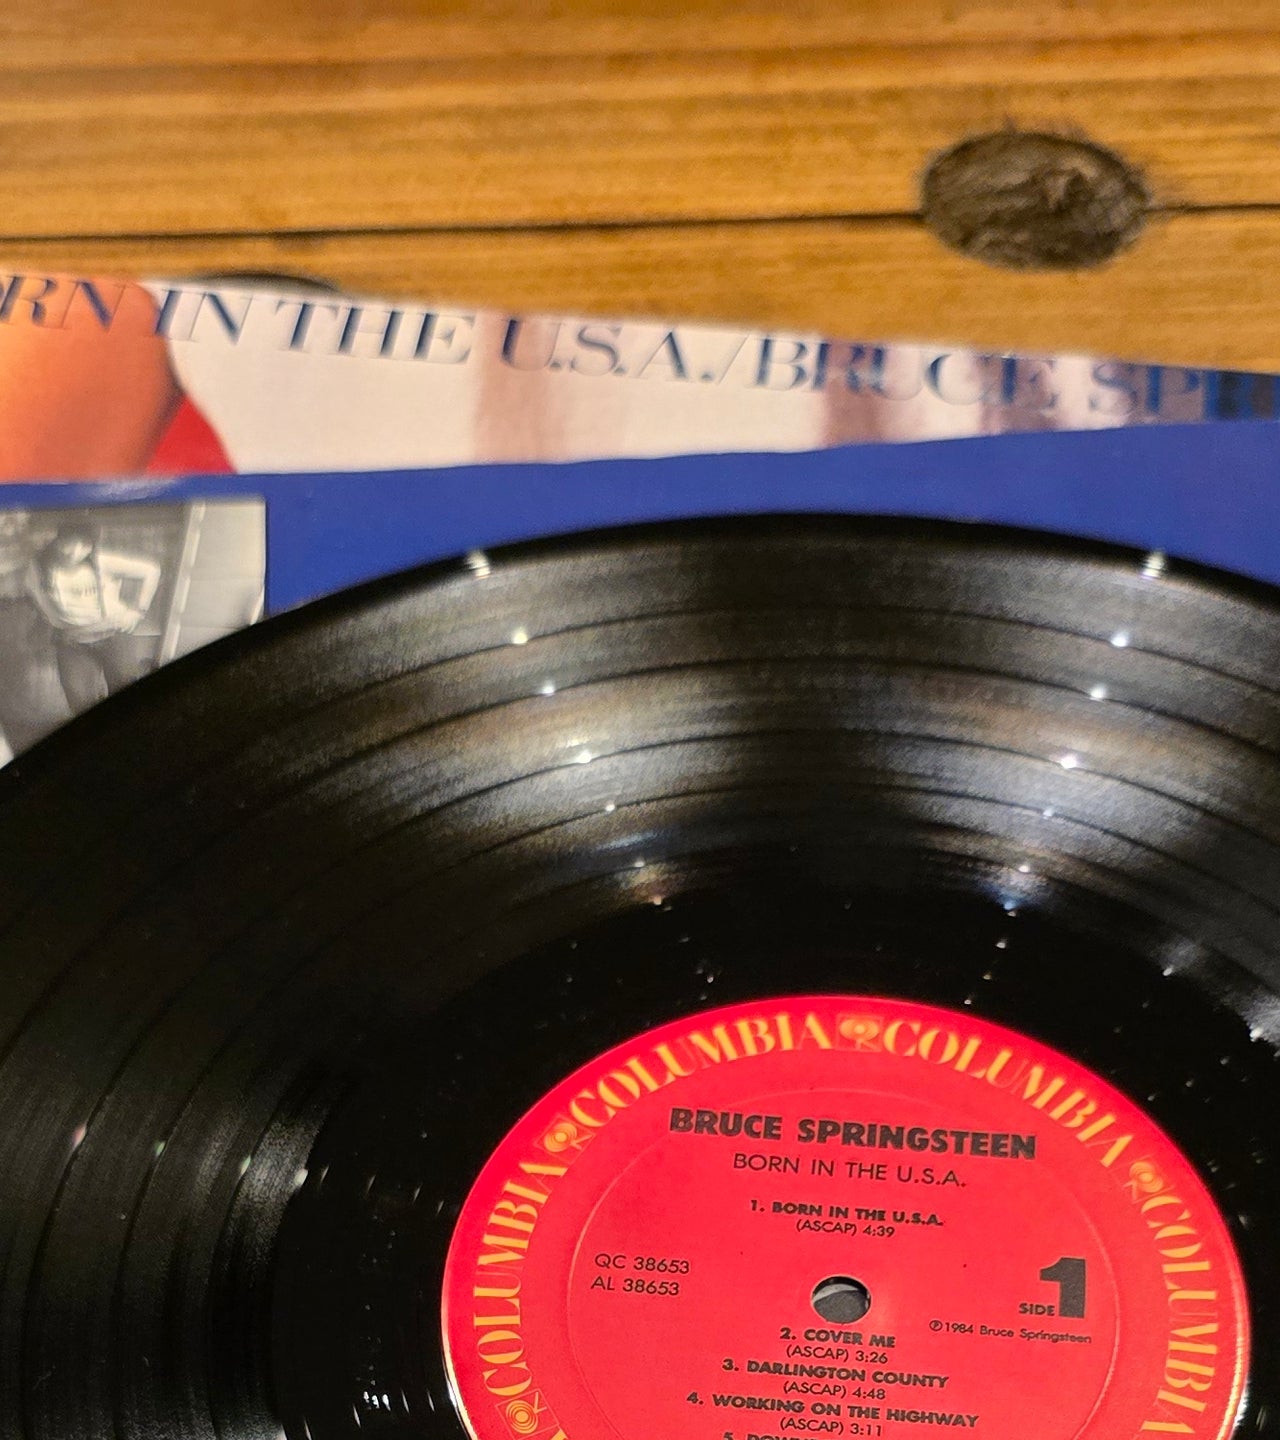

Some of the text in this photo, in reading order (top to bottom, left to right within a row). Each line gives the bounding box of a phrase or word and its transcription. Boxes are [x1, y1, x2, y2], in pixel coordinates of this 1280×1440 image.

[151, 288, 256, 346] IN
[273, 297, 477, 366] THE
[570, 1012, 833, 1128] COLUMBIA
[883, 1019, 1133, 1168] COLUMBIA
[670, 1108, 1037, 1160] BRUCE SPRINGSTEEN
[734, 1153, 965, 1186] BORN IN THE U.S.A.
[751, 1200, 943, 1226] 1. BORN IN THE U.S.A.
[797, 1220, 895, 1238] (ASCAP) 4:39
[473, 1160, 569, 1396] COLUMBIA
[595, 1254, 689, 1274] QC 38653
[591, 1276, 679, 1295] AL 38653
[1019, 1257, 1086, 1318] SIDE 1
[1140, 1195, 1219, 1436] COLUMBIA
[780, 1327, 895, 1348] 2. COVER ME
[980, 1325, 1014, 1337] Bruce
[1020, 1329, 1091, 1343] Springsteen
[786, 1345, 888, 1364] (ASCAP) 3:26
[722, 1359, 949, 1388] 3. DARLINGTON COUNTY
[783, 1381, 885, 1400] (ASCAP) 4:48
[687, 1392, 978, 1427] 4. WORKING ON THE HIGHWAY
[780, 1417, 881, 1436] (ASCAP) 3:11
